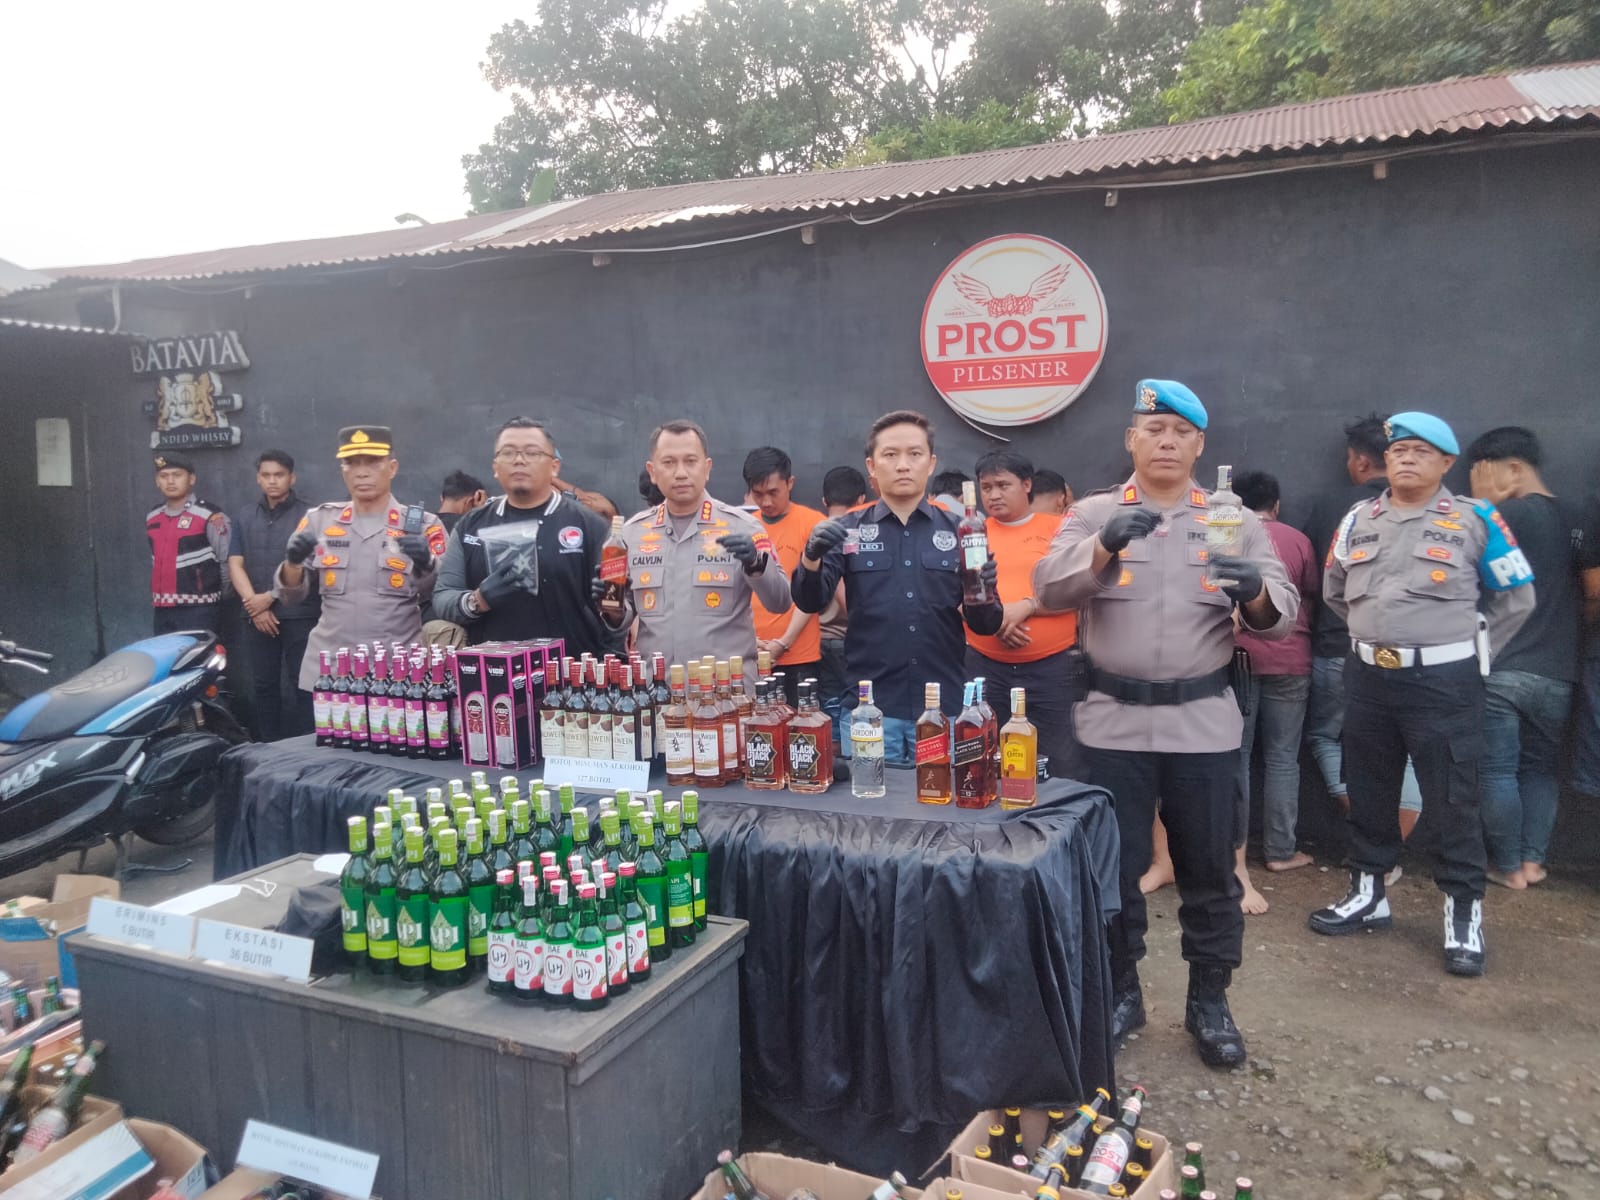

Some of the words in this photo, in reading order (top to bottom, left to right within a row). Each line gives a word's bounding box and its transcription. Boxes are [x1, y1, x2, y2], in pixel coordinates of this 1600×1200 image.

[936, 314, 1086, 357] PROST
[129, 336, 238, 374] BATAVIA
[953, 361, 1069, 383] PILSENER
[961, 536, 987, 548] CAMPAR
[1423, 530, 1464, 547] POLRI
[860, 543, 879, 551] LEO
[225, 928, 283, 951] EKSTASI
[492, 934, 505, 943] BAE
[516, 939, 528, 949] BAE
[547, 944, 561, 954] BAE
[575, 950, 589, 959] BAE
[230, 947, 241, 961] 36
[242, 950, 273, 968] BUTIR
